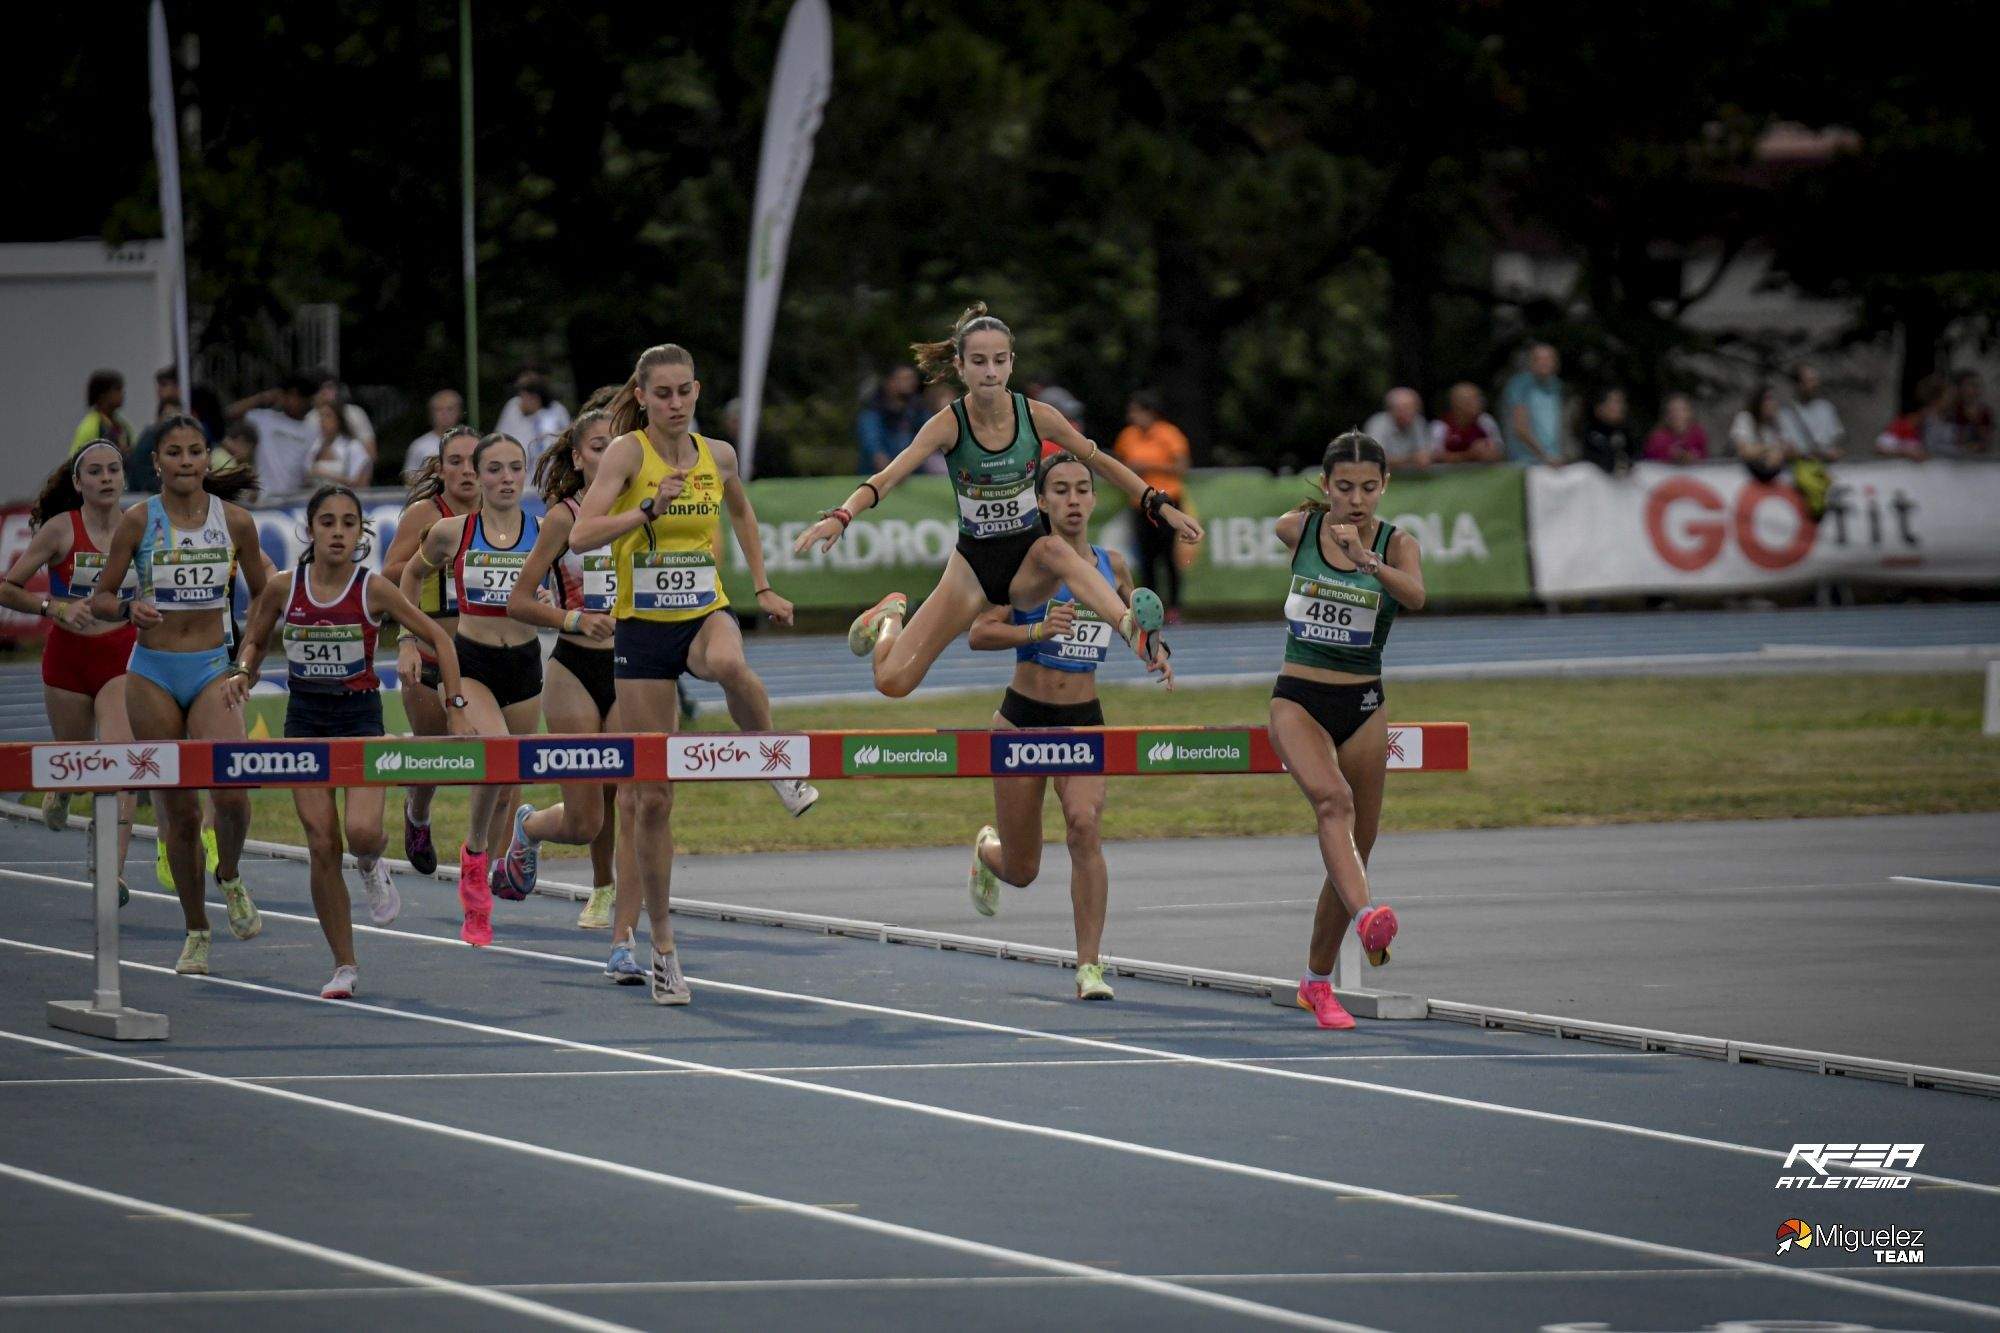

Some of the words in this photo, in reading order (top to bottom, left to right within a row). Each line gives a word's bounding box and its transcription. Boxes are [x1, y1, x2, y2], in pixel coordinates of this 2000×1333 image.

[976, 501, 1019, 519] 498
[729, 518, 958, 573] IBEDRO
[1210, 511, 1491, 567] IBEOLA
[490, 556, 526, 565] IBERDRO
[663, 555, 706, 564] IBERDROLA
[174, 567, 214, 586] 612
[483, 570, 520, 588] 579
[656, 570, 696, 590] 693
[1318, 587, 1366, 604] IBERDROLA
[1306, 602, 1352, 626] 486
[308, 630, 353, 639] IBERDROLA
[303, 644, 342, 661] 541
[882, 748, 948, 763] Iberdrola
[1175, 744, 1241, 760] Iberdrola
[404, 755, 475, 770] Iberdrola
